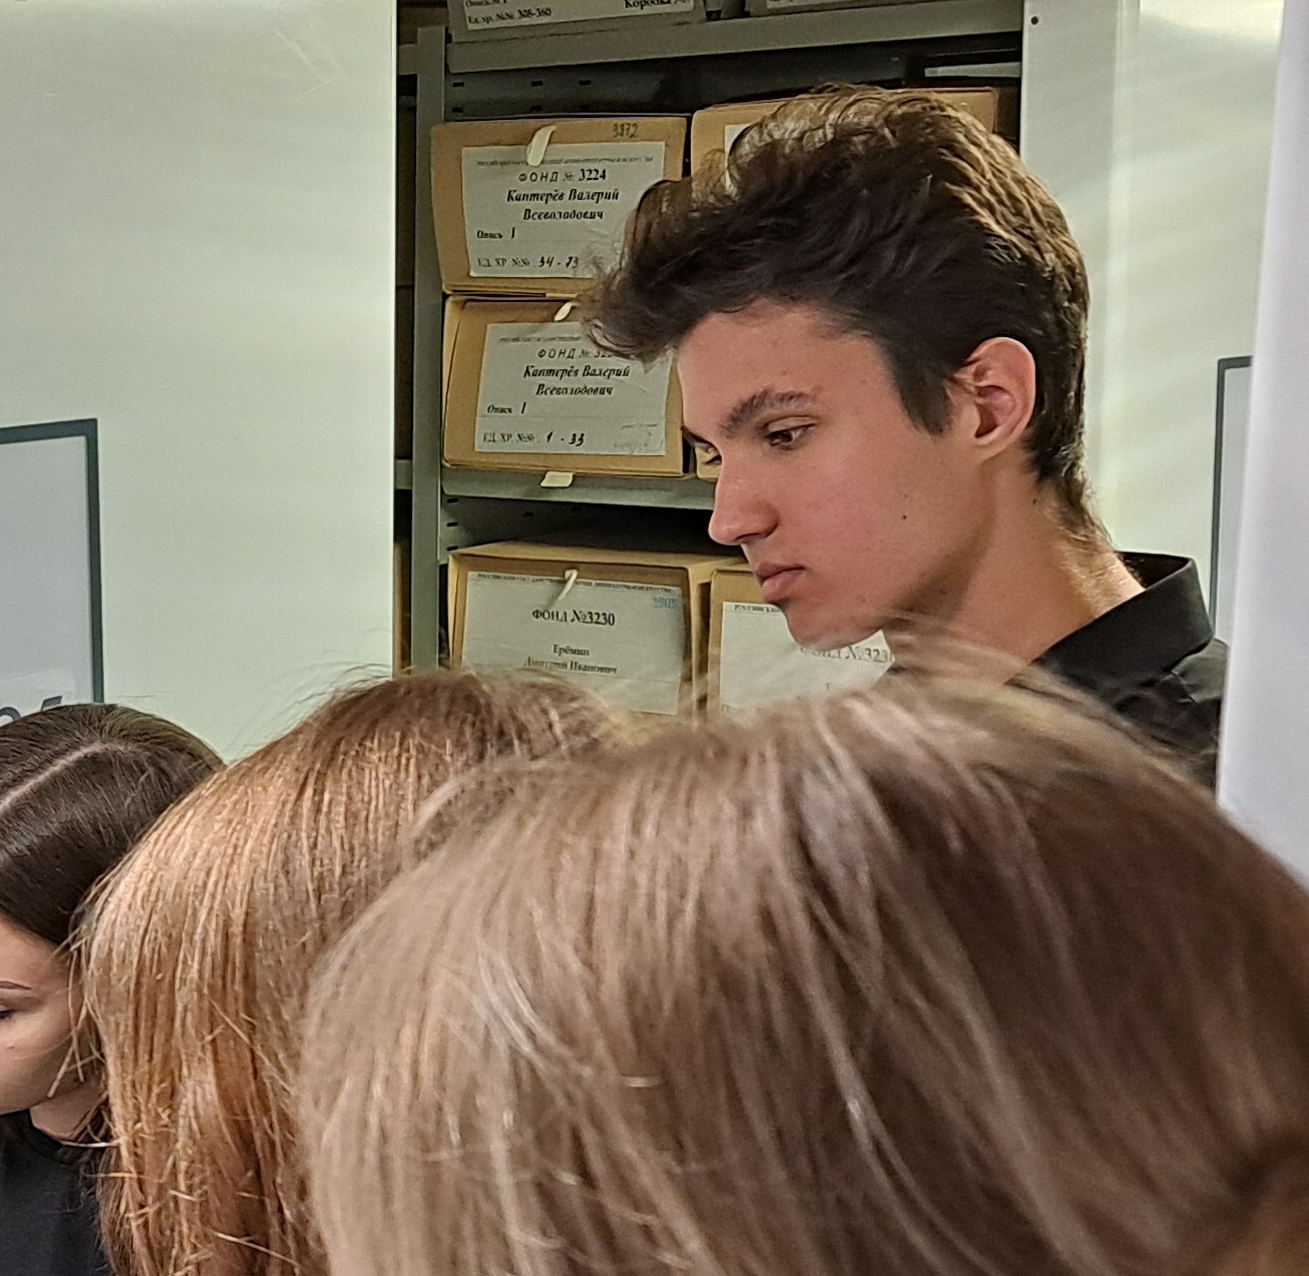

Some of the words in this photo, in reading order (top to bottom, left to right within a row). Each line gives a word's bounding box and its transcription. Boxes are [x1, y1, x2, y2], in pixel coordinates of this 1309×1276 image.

[518, 171, 558, 183] ФОНД
[578, 168, 607, 181] 3224
[568, 187, 620, 204] Валерий
[523, 208, 604, 221] Всеволодович
[537, 348, 576, 360] ФОНД
[582, 364, 631, 379] Валерий
[532, 608, 568, 623] ФОНД
[570, 609, 616, 626] №3230
